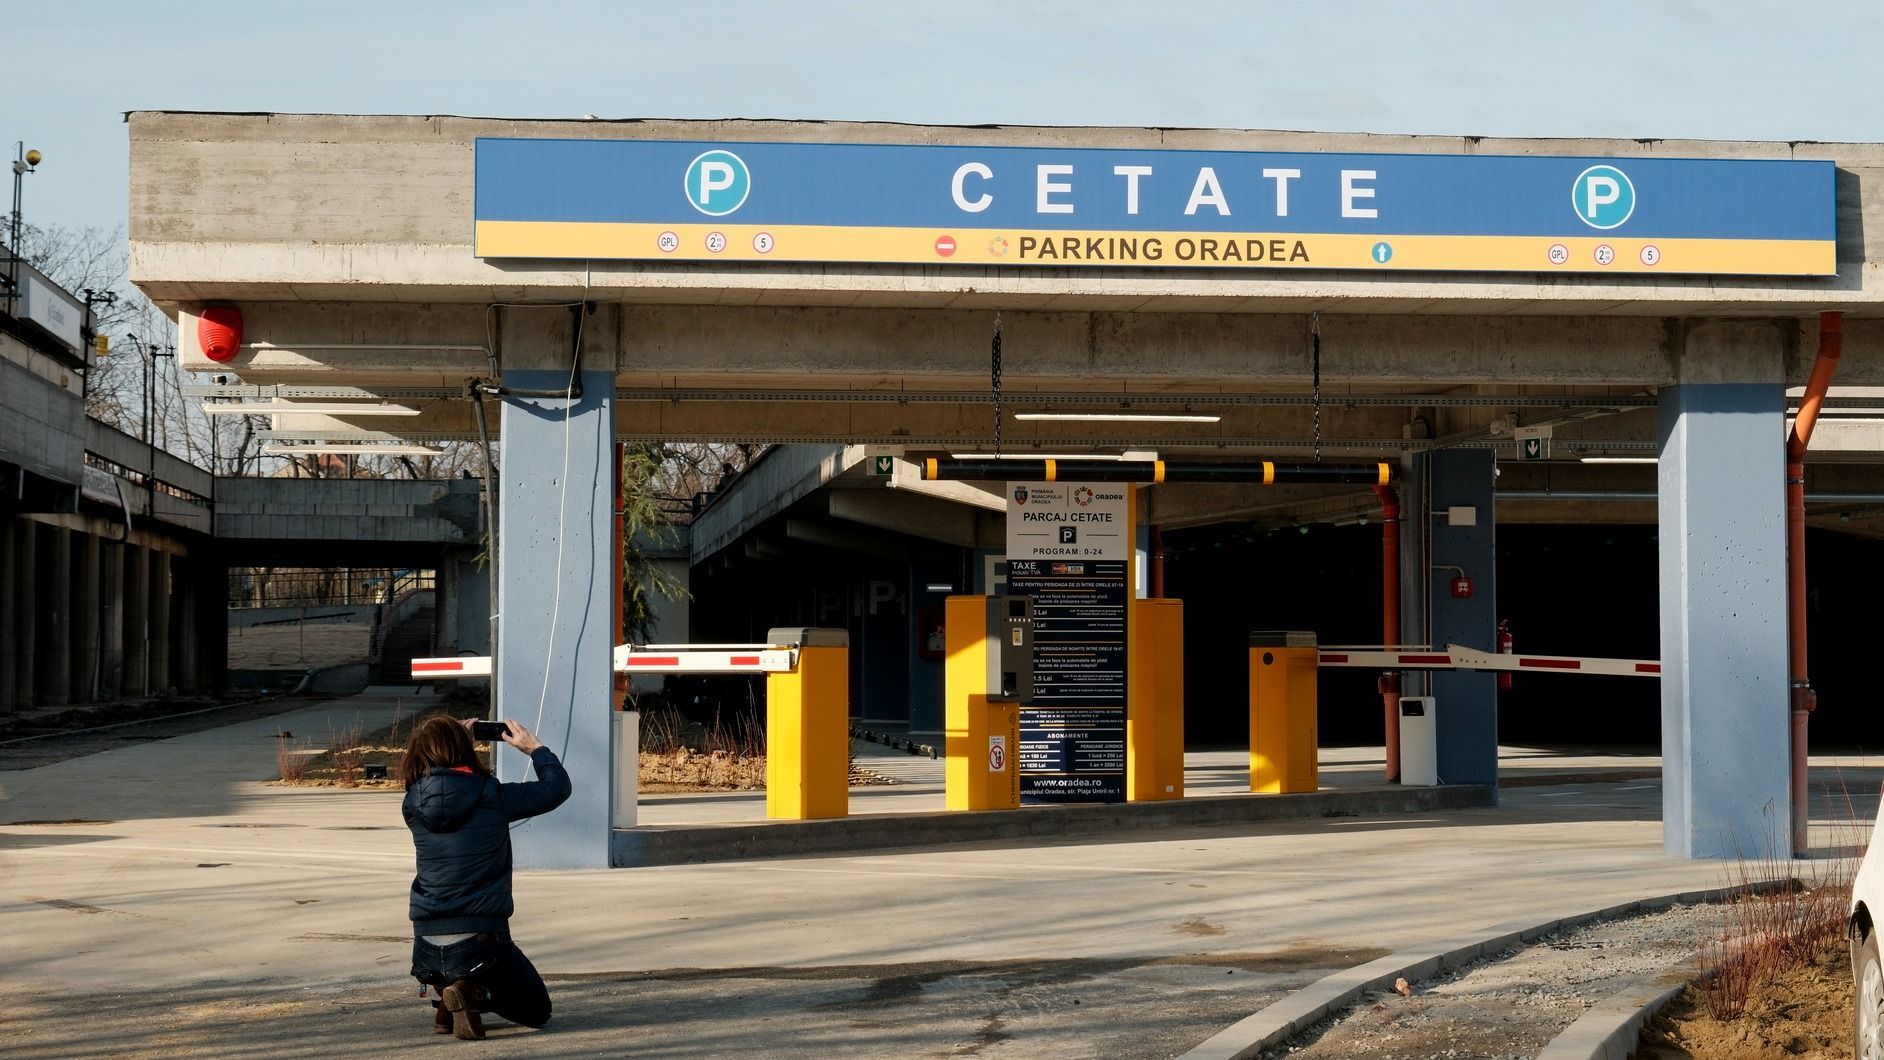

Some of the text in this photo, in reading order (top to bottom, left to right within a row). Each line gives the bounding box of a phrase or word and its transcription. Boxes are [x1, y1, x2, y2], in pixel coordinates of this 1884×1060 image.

[699, 161, 735, 205] P
[951, 162, 1378, 218] CETATE
[1586, 176, 1620, 218] P
[661, 237, 675, 247] GPL
[760, 238, 766, 248] 5
[1019, 236, 1310, 262] PARKING ORADEA
[1551, 250, 1565, 259] GPL
[1647, 250, 1653, 260] 5
[1024, 512, 1112, 522] PARCAJ CETATE
